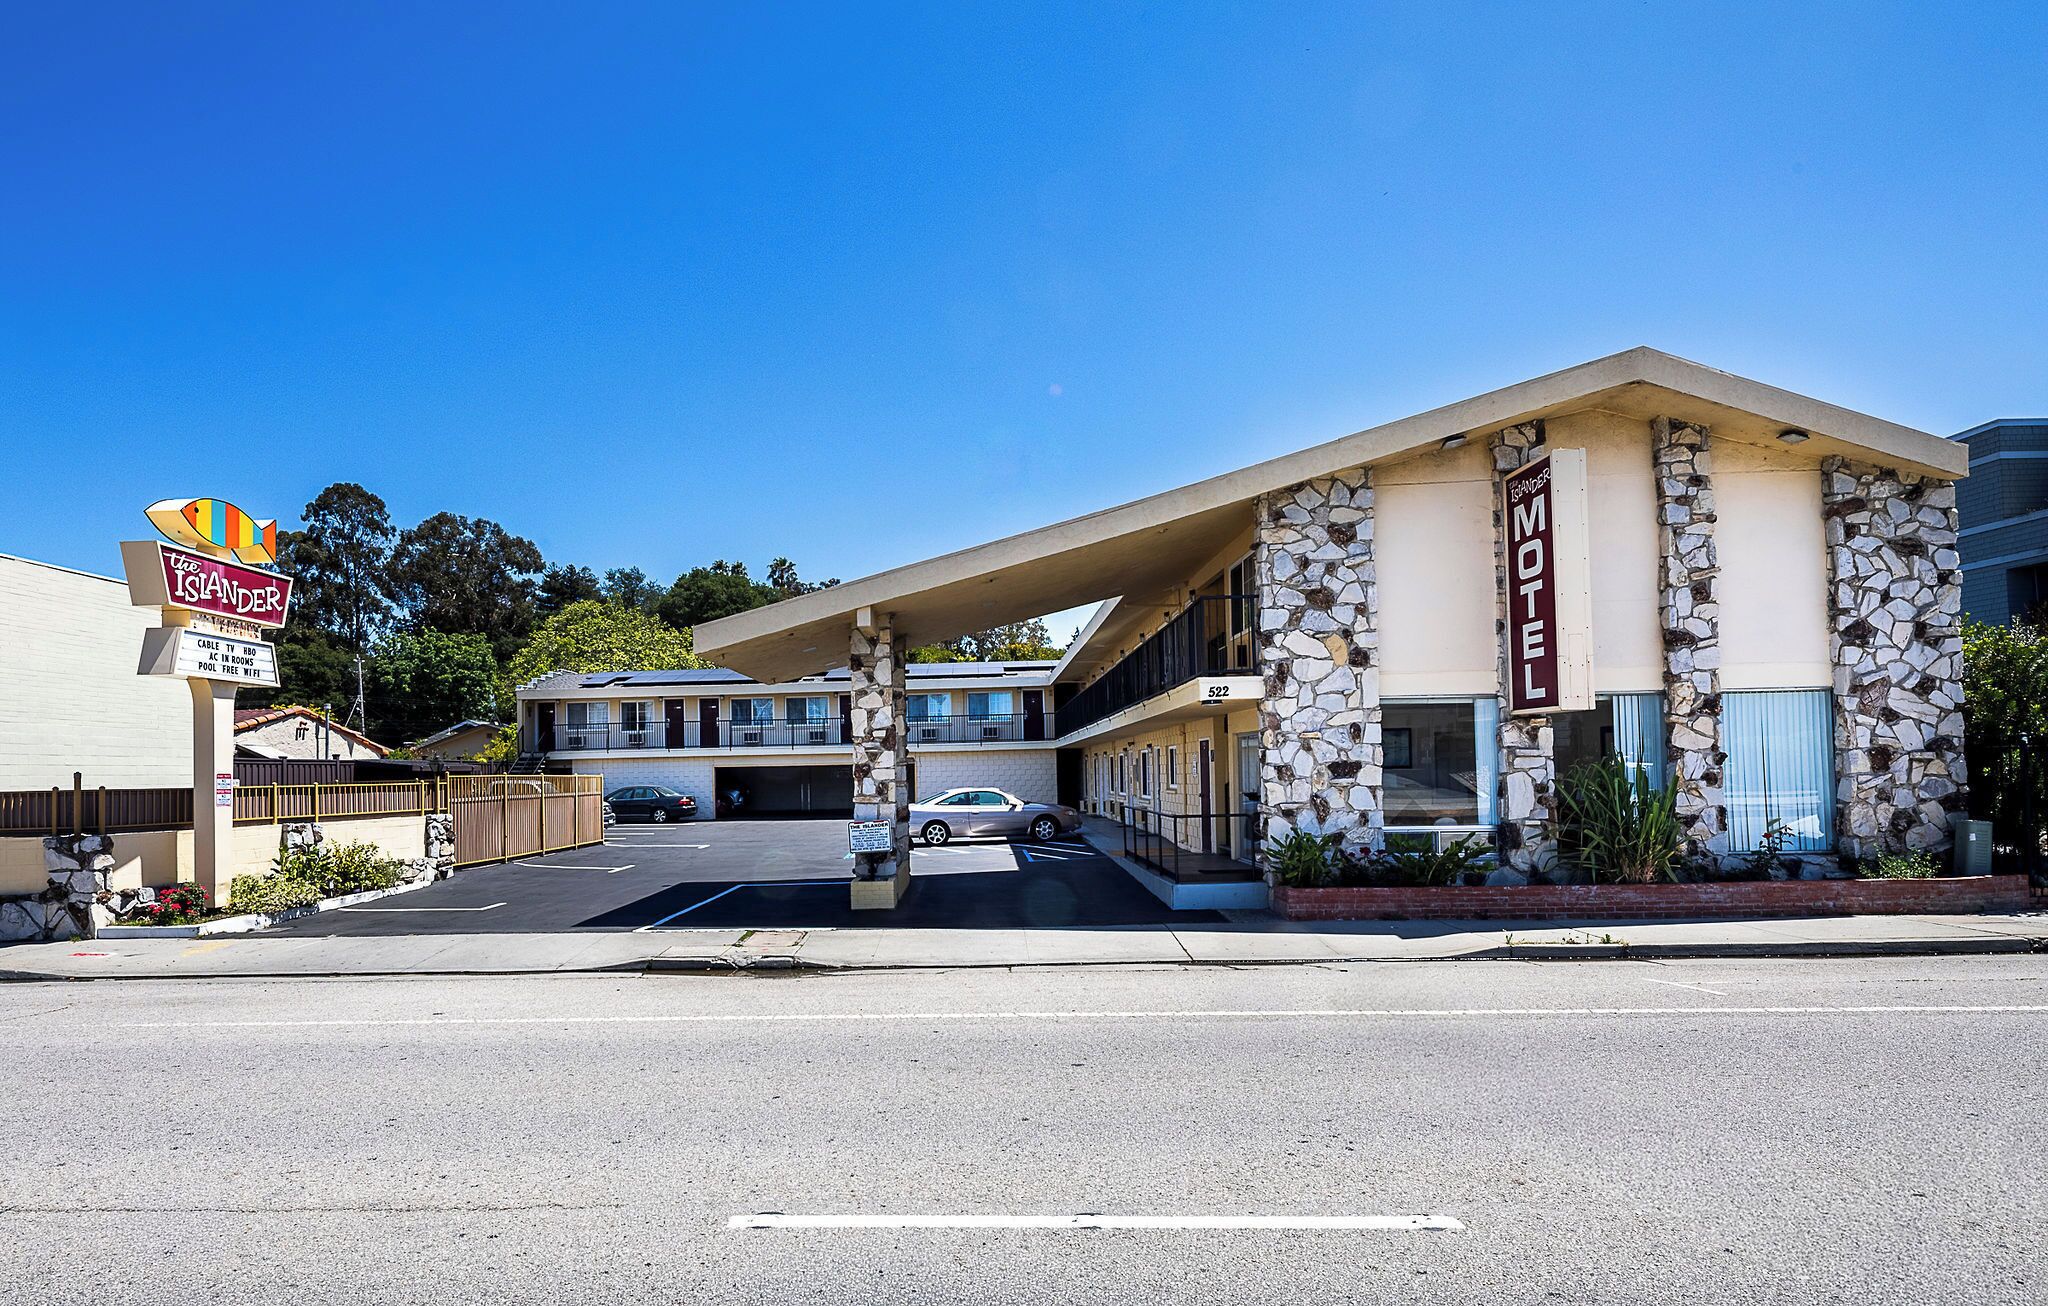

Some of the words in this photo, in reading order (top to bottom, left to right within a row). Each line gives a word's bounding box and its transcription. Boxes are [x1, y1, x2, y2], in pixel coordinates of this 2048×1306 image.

[1511, 467, 1552, 502] ISLANDER
[163, 552, 202, 573] the
[175, 570, 283, 613] ISLANDER
[1513, 494, 1546, 700] MOTEL
[197, 639, 219, 651] CABLE
[226, 643, 235, 653] TV
[243, 646, 257, 657] HBO
[198, 661, 217, 672] POOL
[222, 664, 239, 675] FREE
[209, 652, 218, 662] AC
[221, 653, 229, 663] IN
[231, 655, 254, 667] ROOMS
[1208, 686, 1229, 697] 522
